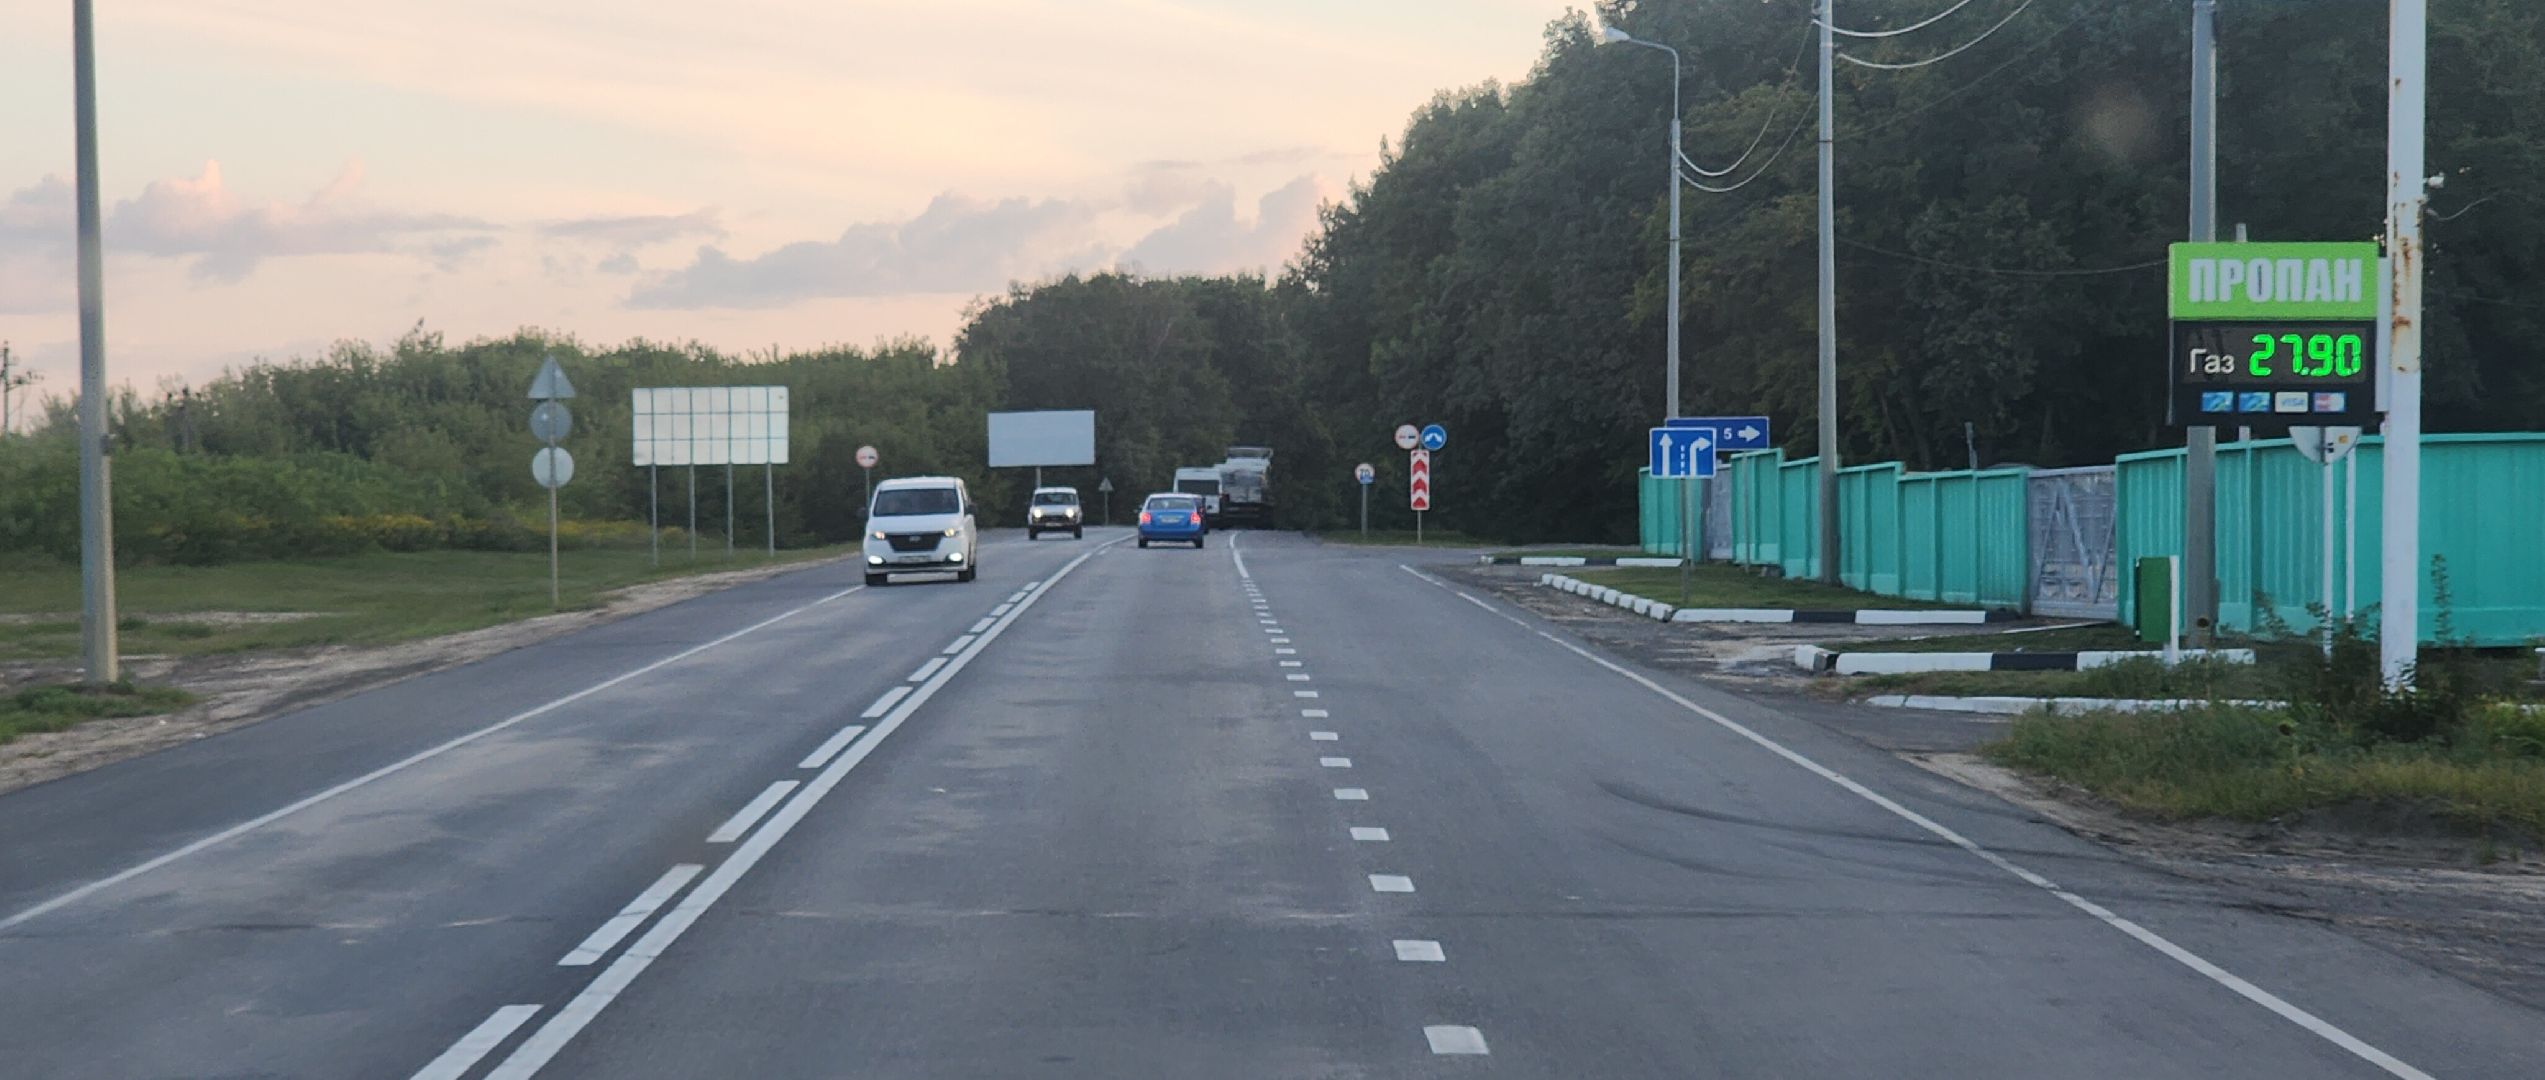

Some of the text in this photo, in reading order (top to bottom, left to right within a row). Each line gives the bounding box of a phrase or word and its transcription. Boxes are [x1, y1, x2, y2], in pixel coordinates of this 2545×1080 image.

[2189, 259, 2363, 303] ПРОПАН
[2189, 334, 2362, 376] Газ 27.90
[1723, 427, 1733, 440] 5
